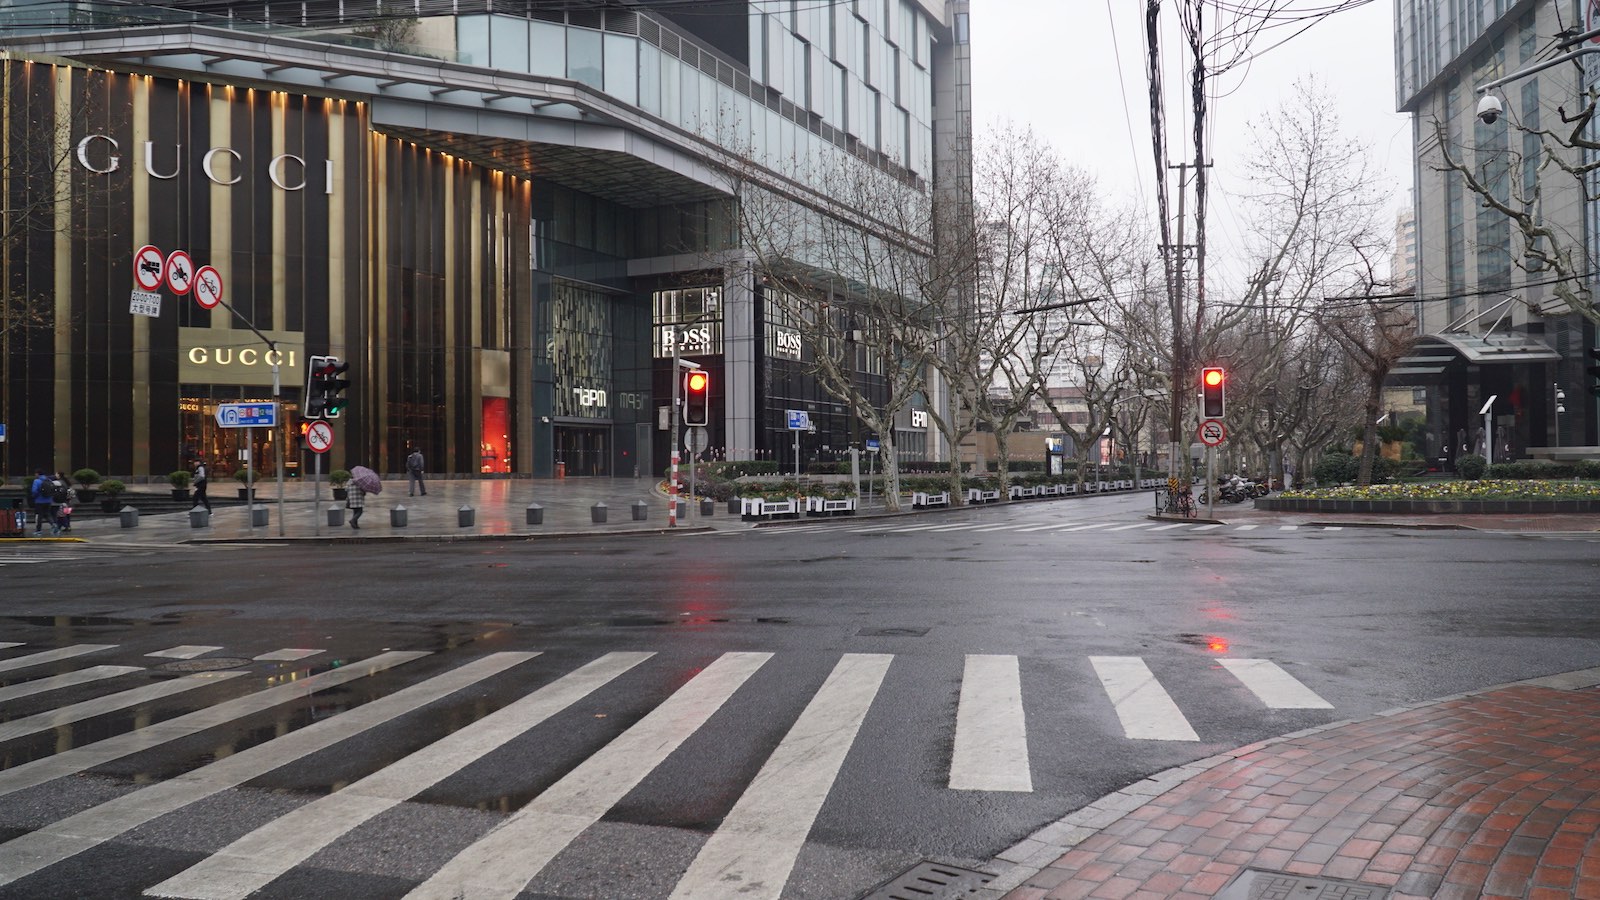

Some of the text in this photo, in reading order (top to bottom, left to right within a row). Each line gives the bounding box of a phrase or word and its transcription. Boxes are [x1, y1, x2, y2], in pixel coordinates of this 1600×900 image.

[77, 134, 333, 195] GUCCI
[777, 331, 801, 350] BOSS
[188, 347, 295, 367] GUCCI
